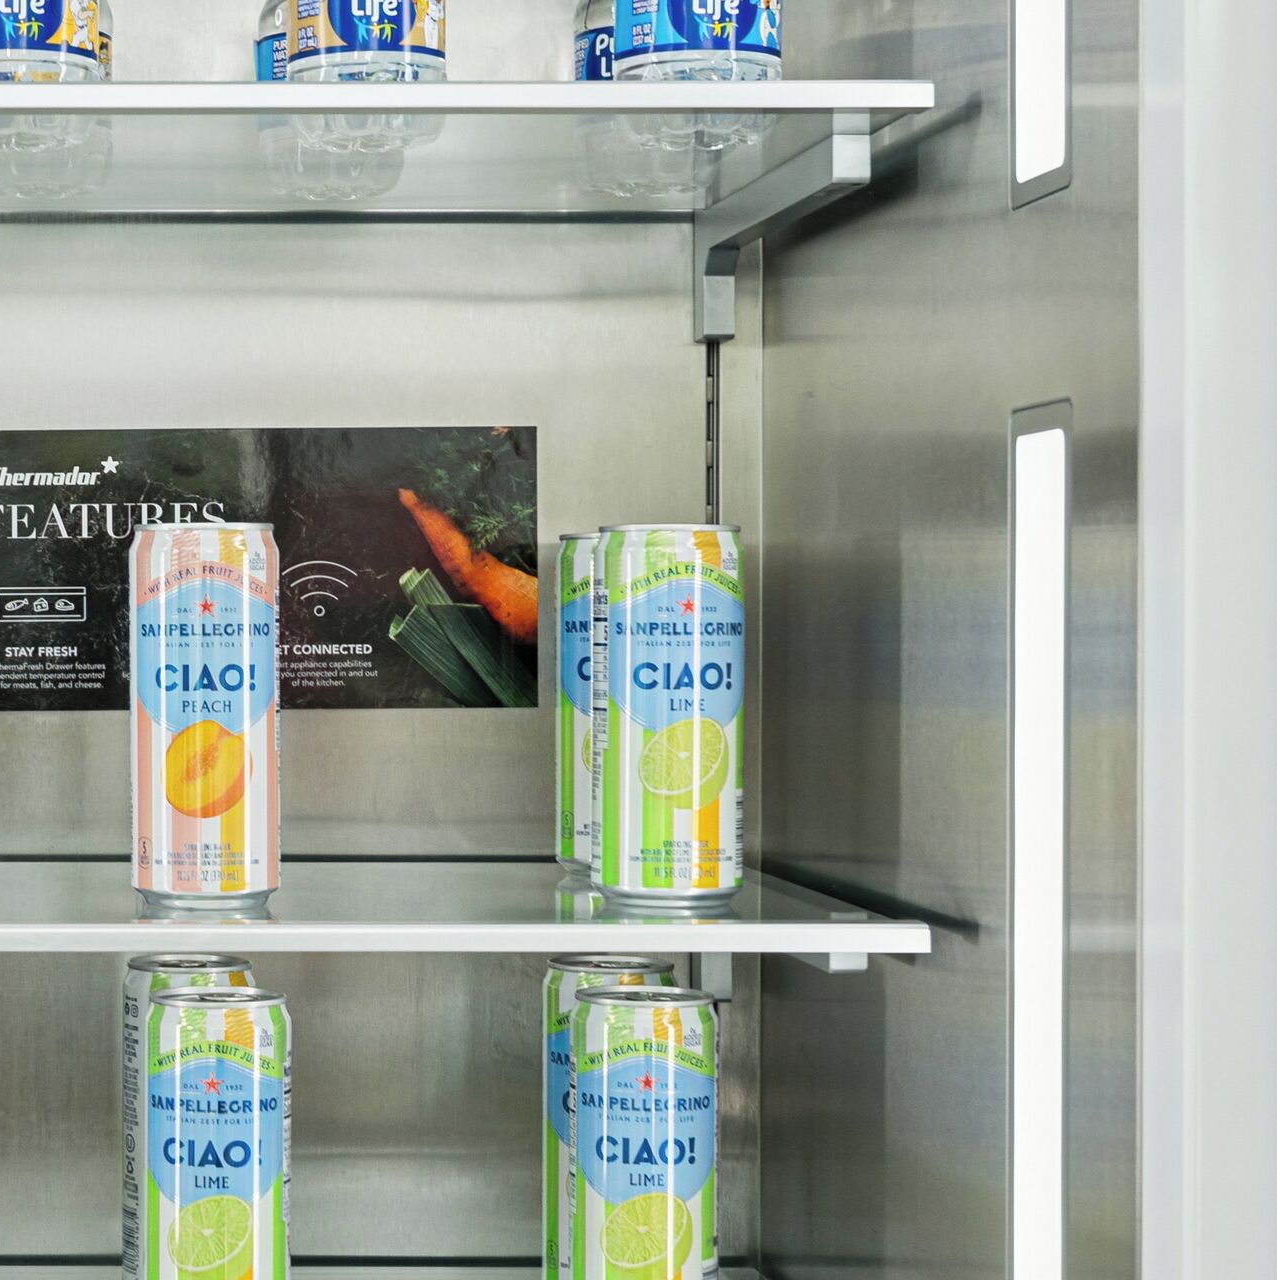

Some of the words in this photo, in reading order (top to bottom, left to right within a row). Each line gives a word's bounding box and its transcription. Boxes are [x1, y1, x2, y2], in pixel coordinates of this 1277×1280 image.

[202, 565, 233, 578] FRUIT
[653, 564, 682, 581] REAL
[4, 646, 35, 657] STAY
[38, 646, 78, 657] FRESH
[292, 643, 373, 655] CONNECTED
[45, 662, 73, 671] Drawer
[74, 661, 106, 670] features
[289, 660, 328, 670] appliance
[328, 659, 373, 669] capabilities
[28, 672, 77, 681] temperature
[77, 671, 106, 679] control
[155, 663, 257, 692] CIAO!
[280, 671, 295, 679] you
[296, 669, 338, 678] connected
[339, 669, 347, 677] in
[348, 669, 364, 677] and
[632, 662, 733, 690] CIAO!
[0, 681, 11, 689] for
[12, 681, 39, 690] meats,
[40, 681, 57, 690] fish,
[57, 681, 73, 689] and
[74, 681, 104, 689] cheese.
[291, 679, 301, 687] of
[301, 678, 315, 687] the
[315, 678, 346, 687] kitchen.
[182, 700, 232, 713] PEACH
[180, 1045, 205, 1059] REAL
[208, 1044, 238, 1056] FRUIT
[613, 1043, 640, 1056] REAL
[674, 1050, 704, 1070] JUICES
[617, 1081, 633, 1089] DAL
[150, 1094, 279, 1115] SANPELLEGRNO
[162, 1137, 263, 1169] CIAO!
[595, 1135, 696, 1166] CIAO!
[194, 1175, 231, 1190] LIME
[629, 1173, 666, 1188] LIME
